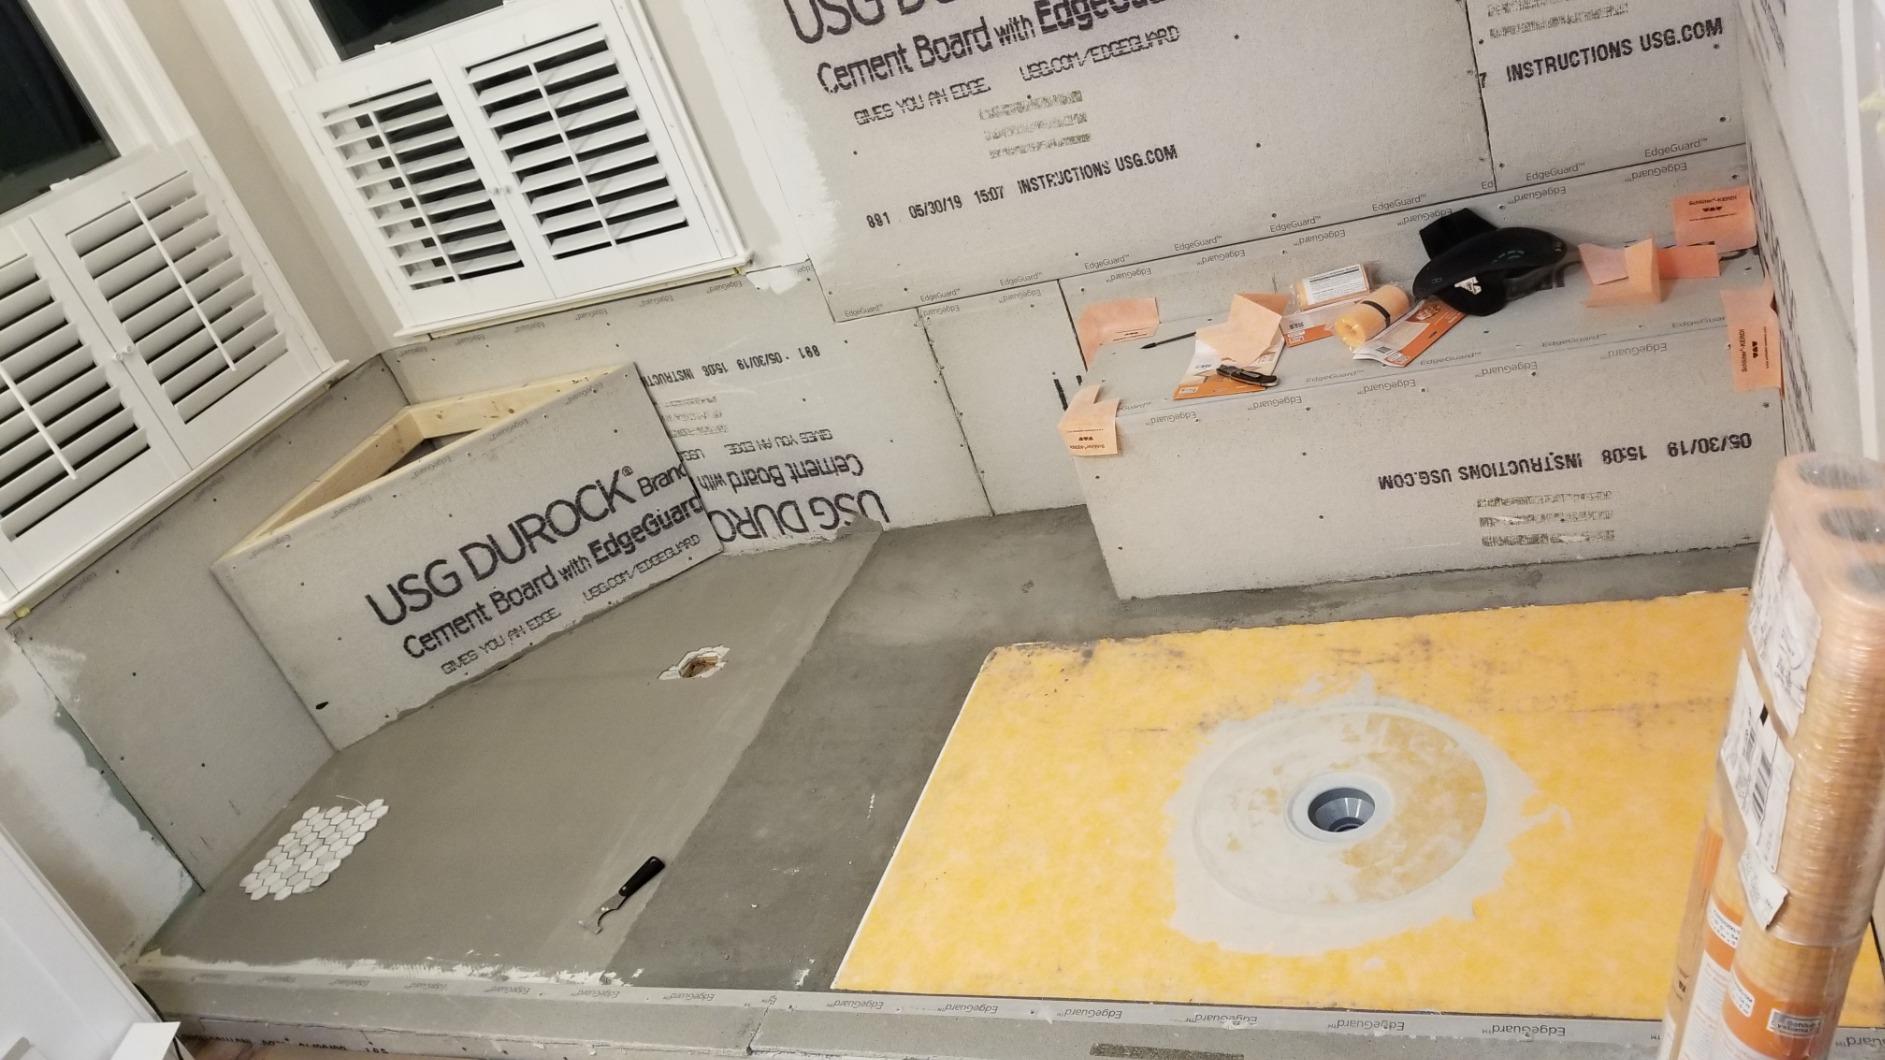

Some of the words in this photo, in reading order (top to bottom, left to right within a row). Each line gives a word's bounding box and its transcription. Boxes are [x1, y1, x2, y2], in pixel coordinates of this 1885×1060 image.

[816, 43, 914, 93] Cement
[912, 16, 993, 68] Board
[993, 15, 1036, 46] with
[1506, 38, 1633, 82] INSTRUCTIONS
[1639, 17, 1723, 51] USG.COM
[853, 103, 895, 125] GIVES
[895, 94, 926, 113] YOU
[927, 88, 949, 106] AN
[866, 211, 891, 229] 891
[908, 195, 963, 219] 05/30/19
[974, 185, 1005, 204] 15:07
[1017, 160, 1111, 194] INSTRUCTIONS
[1115, 144, 1179, 171] USG.COM
[737, 351, 783, 371] 05/30/19
[798, 344, 821, 360] 891
[1601, 444, 1648, 465] 15:08
[1667, 432, 1753, 458] 05/30/19
[696, 472, 727, 492] with
[726, 465, 785, 494] Board
[784, 453, 864, 479] Cement
[1377, 468, 1452, 491] USG.COM
[1458, 451, 1584, 482] INSTRUCTIONS
[706, 499, 810, 543] DURO
[808, 489, 891, 531] USG
[365, 559, 465, 627] USG
[403, 600, 493, 659] Cement
[488, 565, 560, 616] Board
[556, 553, 593, 583] with
[440, 649, 479, 675] GIVES
[478, 635, 506, 654] YOU
